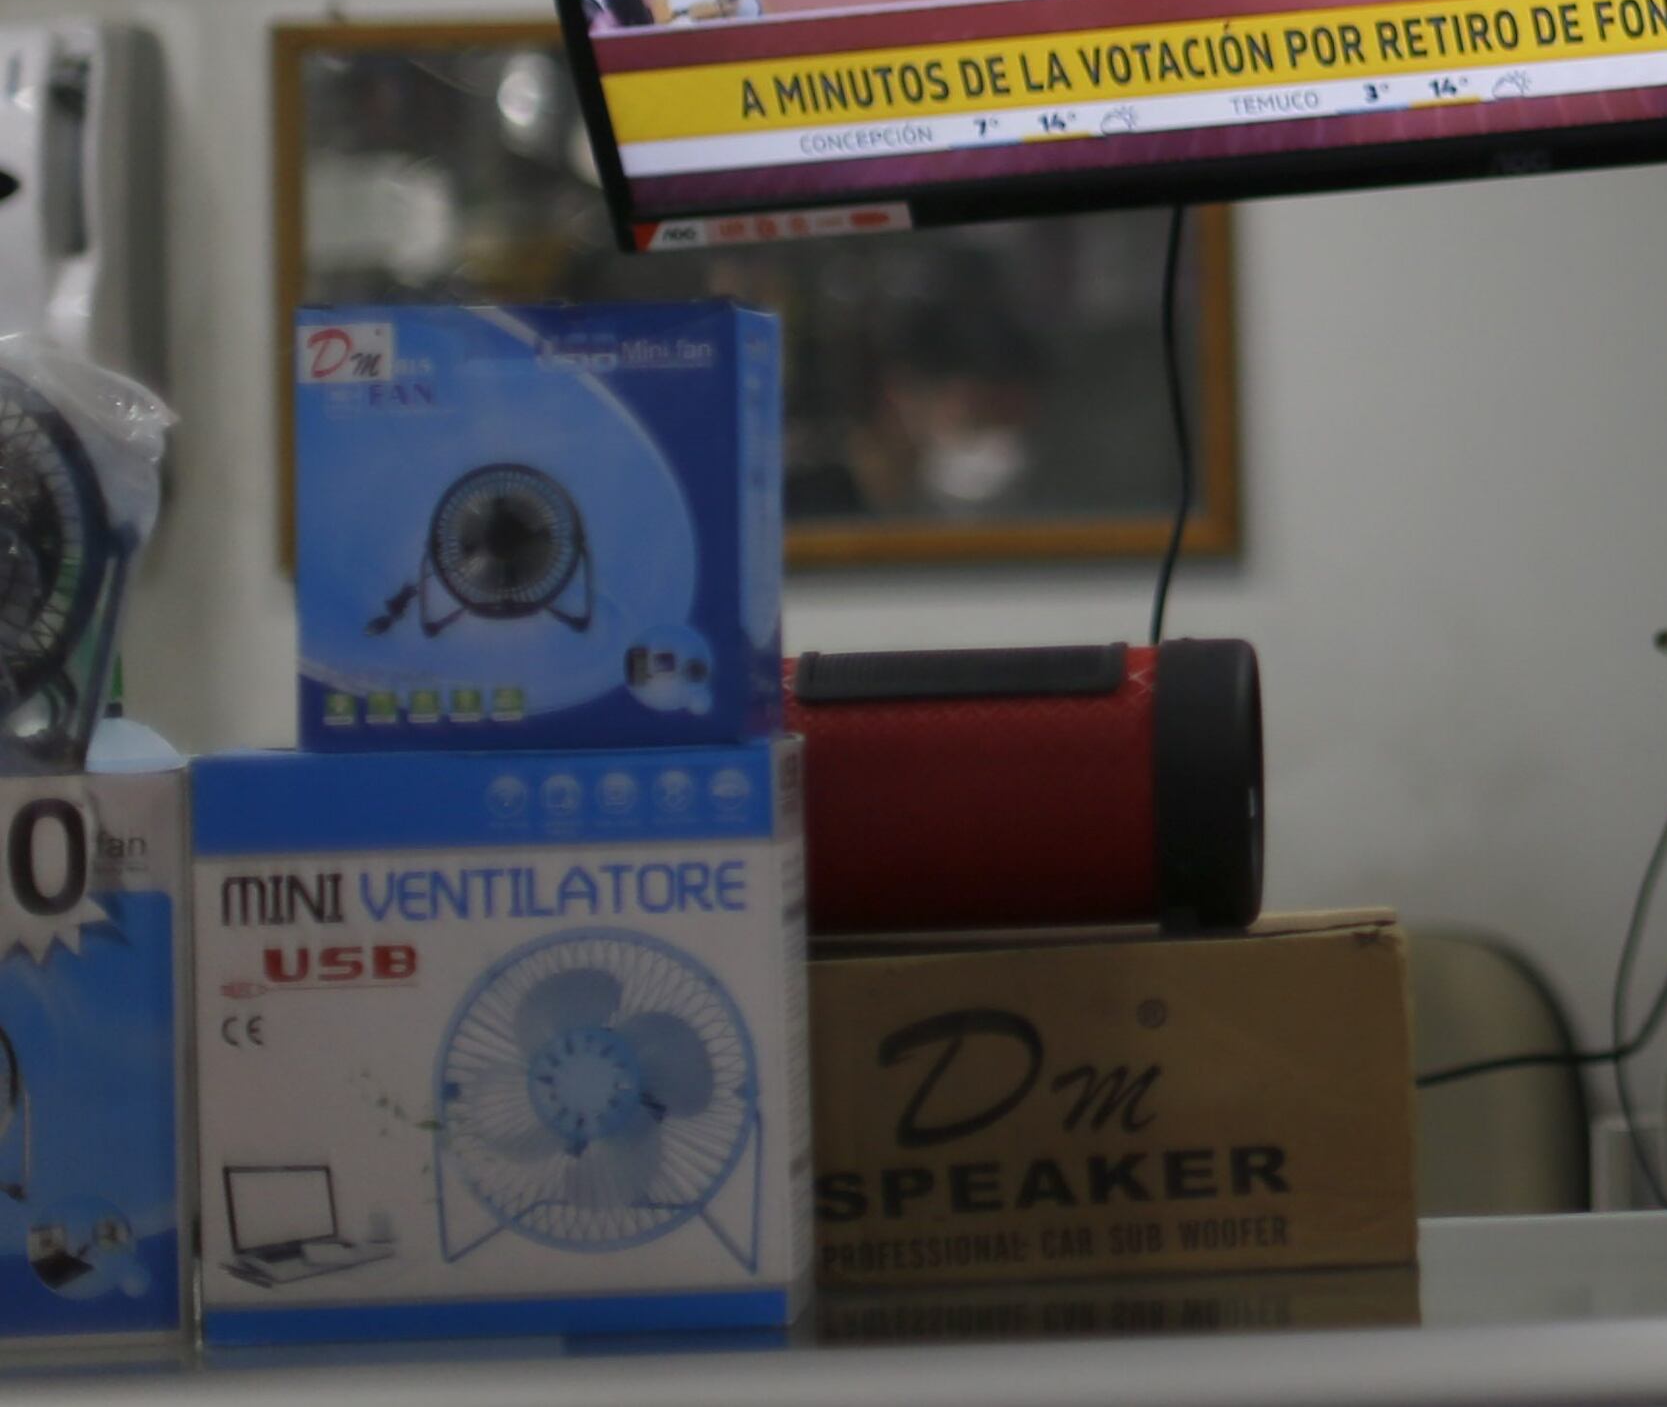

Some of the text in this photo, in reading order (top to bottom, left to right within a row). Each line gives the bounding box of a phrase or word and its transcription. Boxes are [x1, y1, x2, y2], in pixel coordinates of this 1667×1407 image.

[741, 78, 767, 120] A
[776, 60, 950, 118] MINUTOS
[959, 55, 1011, 96] DE
[1021, 49, 1072, 92] LA
[1078, 21, 1276, 88] VOTACIÓN
[1286, 24, 1365, 69] POR
[1376, 10, 1519, 60] RETIRO
[1531, 4, 1584, 46] DE
[1229, 90, 1320, 118] TEMUCO
[799, 120, 932, 156] CONCEPCIÓN
[368, 384, 433, 406] FAN
[7, 798, 87, 916] 0
[221, 860, 748, 926] MINI VENTILATORE
[263, 944, 417, 983] USB
[221, 1014, 264, 1046] CE
[813, 1144, 1292, 1223] SPEAKER
[822, 1215, 1289, 1275] PROFESSIONAL CAR SUB WOOFER
